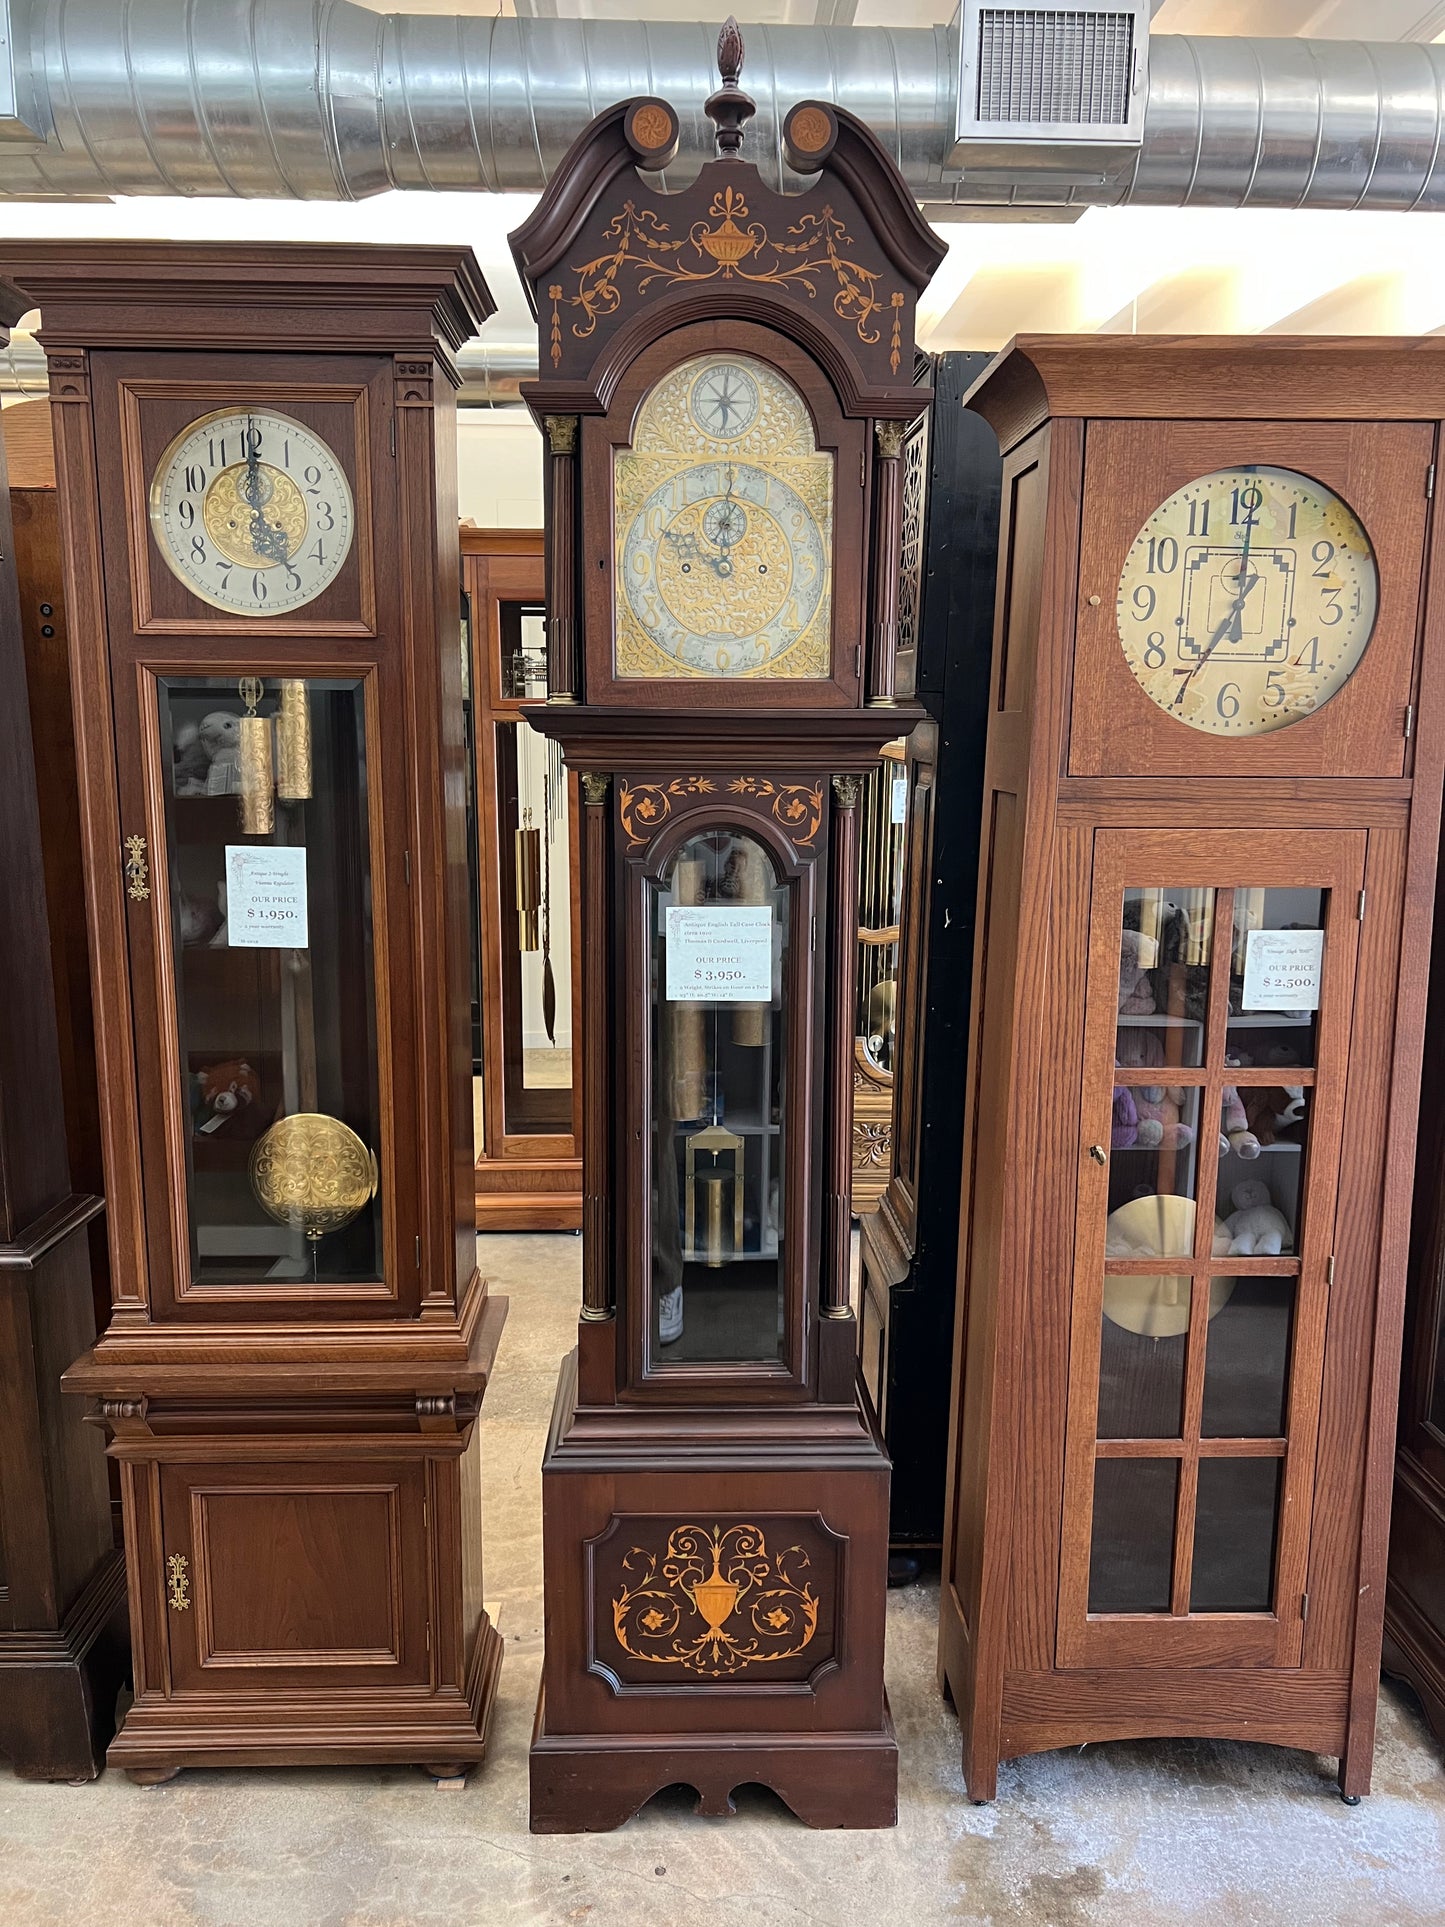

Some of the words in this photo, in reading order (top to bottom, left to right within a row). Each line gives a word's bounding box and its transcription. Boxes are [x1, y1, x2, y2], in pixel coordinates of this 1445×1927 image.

[208, 438, 226, 467] 11
[240, 428, 262, 458] 12
[283, 439, 289, 468] 1
[183, 463, 206, 493] 10
[304, 465, 321, 495] 2
[716, 466, 739, 497] 12
[671, 477, 688, 511] 11
[762, 478, 771, 510] 1
[1229, 487, 1263, 526] 12
[178, 500, 194, 529] 9
[316, 501, 335, 531] 3
[643, 507, 666, 541] 10
[791, 513, 808, 543] 2
[1186, 499, 1210, 537] 11
[1286, 502, 1297, 539] 1
[190, 535, 207, 565] 8
[307, 537, 327, 565] 4
[1146, 536, 1179, 574] 10
[1311, 540, 1335, 578] 2
[216, 561, 233, 590] 7
[285, 563, 302, 591] 5
[632, 552, 649, 588] 9
[799, 555, 816, 589] 3
[252, 571, 267, 601] 6
[782, 600, 800, 630] 4
[1131, 585, 1156, 621] 9
[1318, 588, 1343, 625] 3
[672, 630, 688, 660] 7
[716, 640, 730, 670] 6
[754, 633, 770, 660] 5
[1143, 631, 1166, 669] 8
[1293, 636, 1323, 674] 4
[1172, 668, 1195, 704] 7
[1216, 682, 1241, 718] 6
[1262, 670, 1287, 707] 5
[247, 908, 255, 918] $
[258, 910, 298, 920] 1,950.
[694, 969, 702, 979] $
[705, 971, 746, 981] 3,950.
[1263, 977, 1270, 987] $
[1274, 979, 1315, 988] 2,500.
